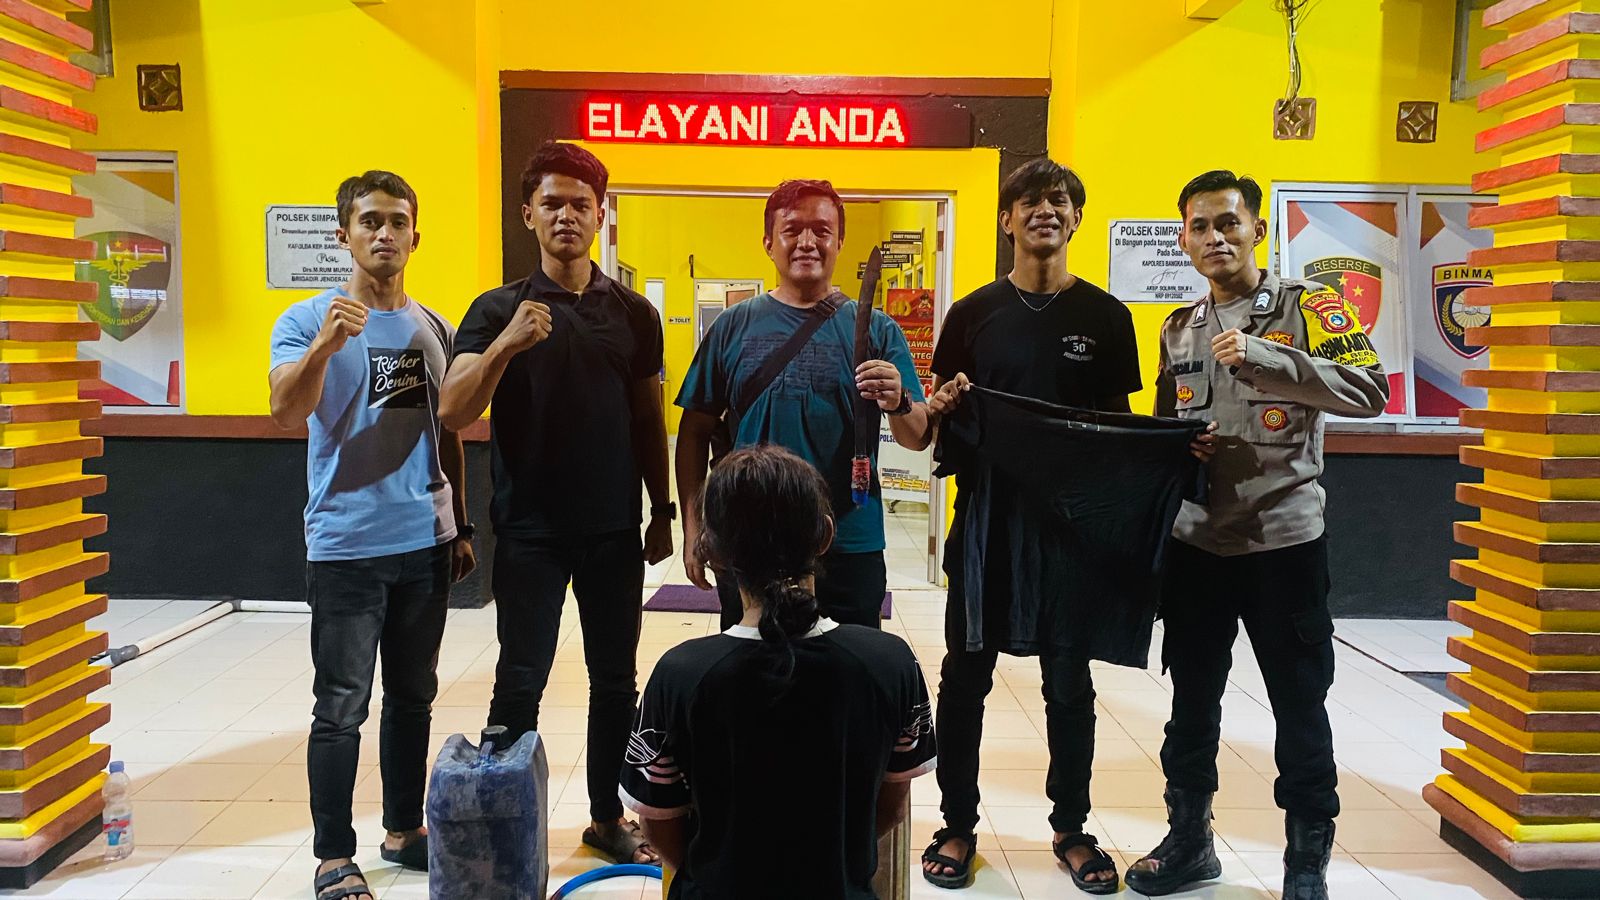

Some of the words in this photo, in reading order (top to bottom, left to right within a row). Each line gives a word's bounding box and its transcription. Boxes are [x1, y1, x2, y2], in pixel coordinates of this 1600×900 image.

[588, 102, 768, 141] ELAYANI
[786, 106, 905, 143] ANDA
[276, 213, 310, 222] POLSEK
[1120, 226, 1153, 236] POLSEK
[1122, 239, 1142, 247] Bangun
[1143, 239, 1157, 248] pada
[1158, 239, 1177, 247] tanggal
[1313, 259, 1371, 273] RESERSE
[1443, 268, 1494, 280] BINMA
[371, 353, 421, 375] Richer
[375, 373, 420, 393] Denim
